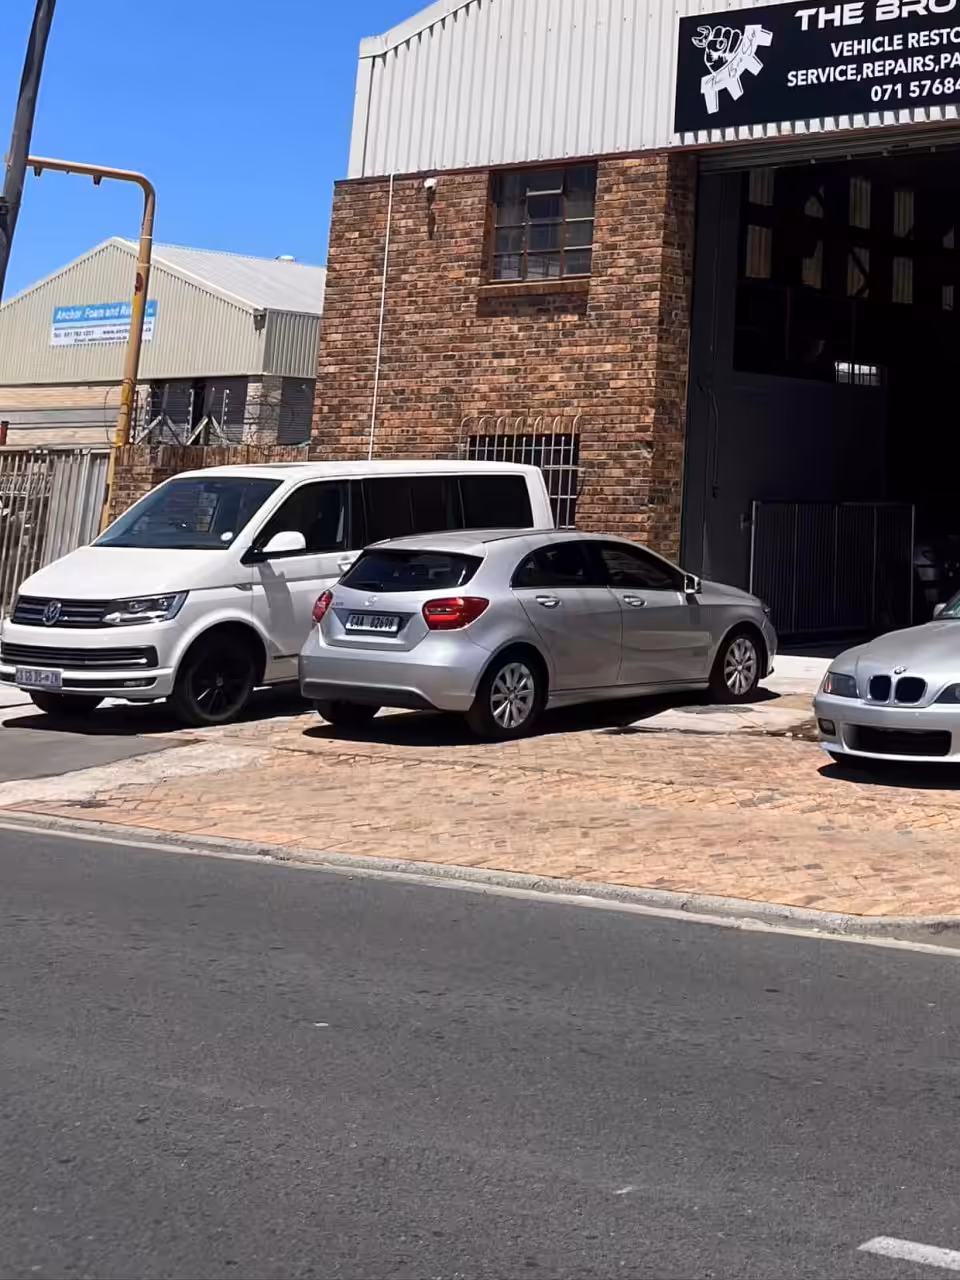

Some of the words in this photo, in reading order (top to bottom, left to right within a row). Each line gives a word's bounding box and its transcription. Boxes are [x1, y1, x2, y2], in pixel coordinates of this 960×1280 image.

[795, 2, 865, 31] THE
[831, 34, 903, 57] VEHICLE
[871, 83, 902, 101] 071
[85, 307, 104, 318] Foam
